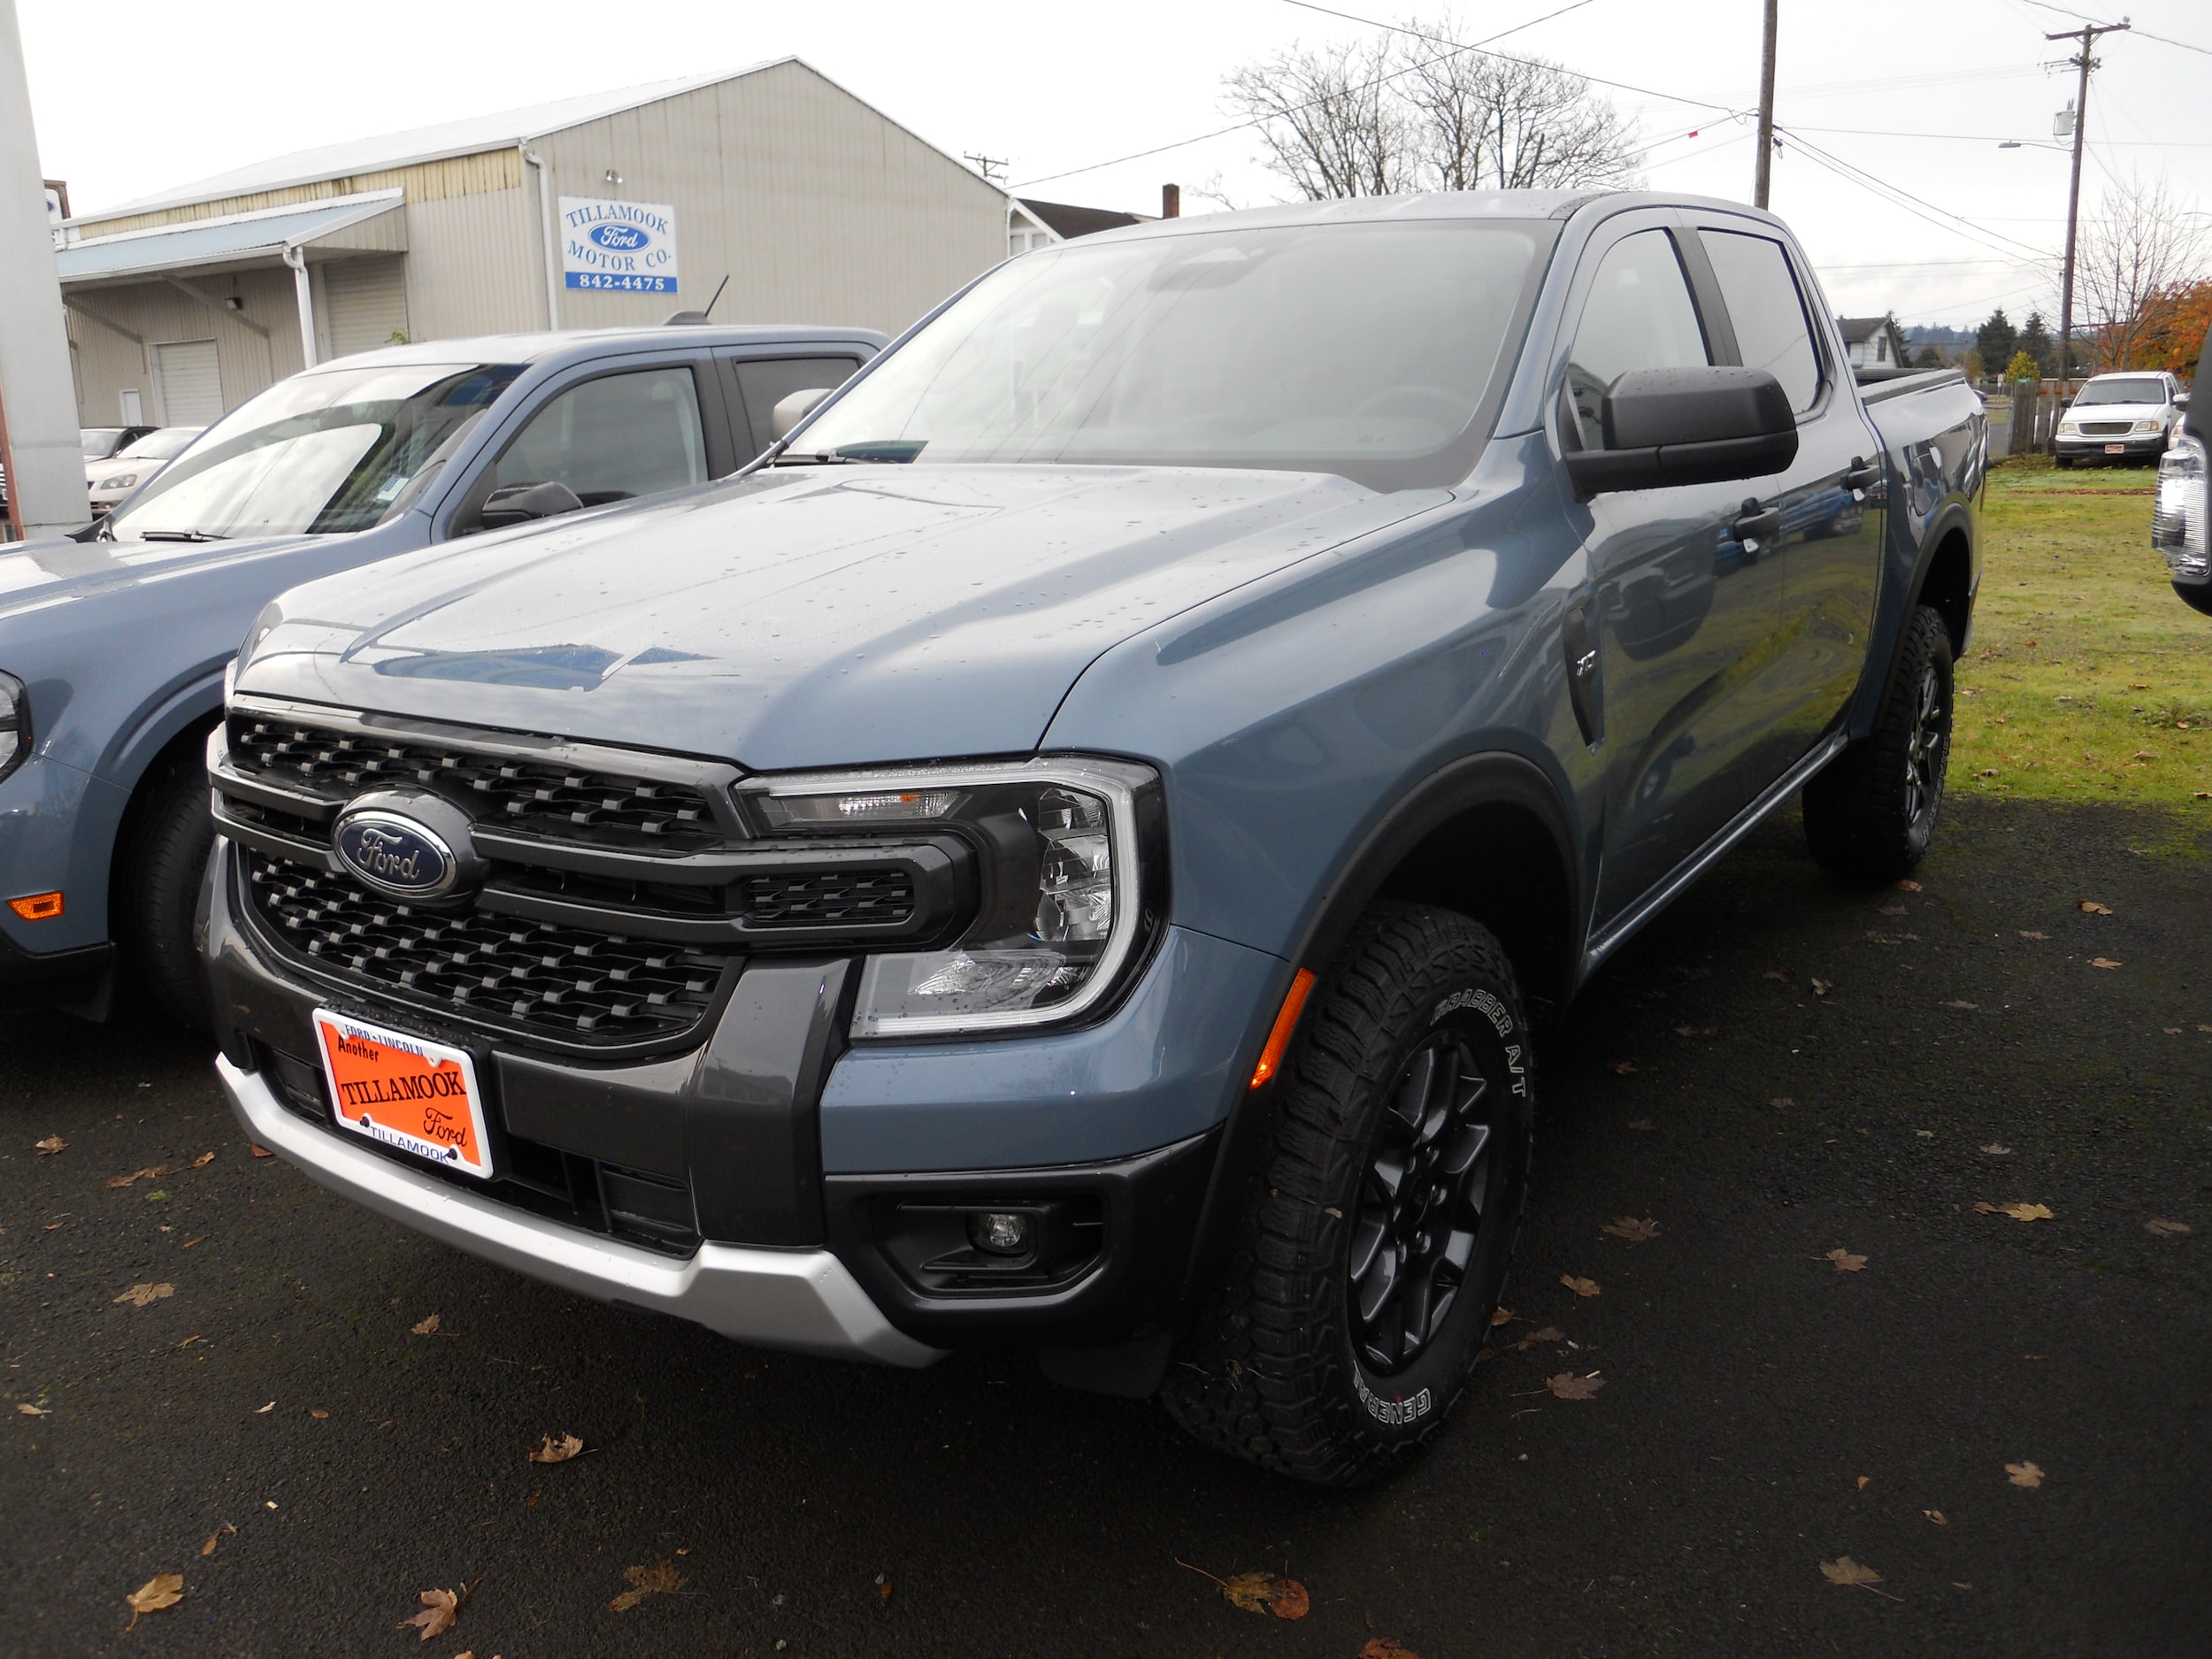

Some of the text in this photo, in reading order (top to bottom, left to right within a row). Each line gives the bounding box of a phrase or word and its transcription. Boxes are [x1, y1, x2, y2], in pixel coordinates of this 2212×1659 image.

[566, 204, 668, 235] TILLAMOOK
[600, 226, 638, 248] Ford
[567, 240, 671, 271] MOTOR CO.
[580, 273, 664, 291] 842-4475
[357, 827, 420, 879] Ford
[338, 1033, 379, 1062] Another
[1505, 1045, 1525, 1097] A/T
[341, 1071, 467, 1105] TILLAMOOK
[423, 1107, 467, 1147] Ford
[370, 1125, 449, 1164] TILLAMOOK
